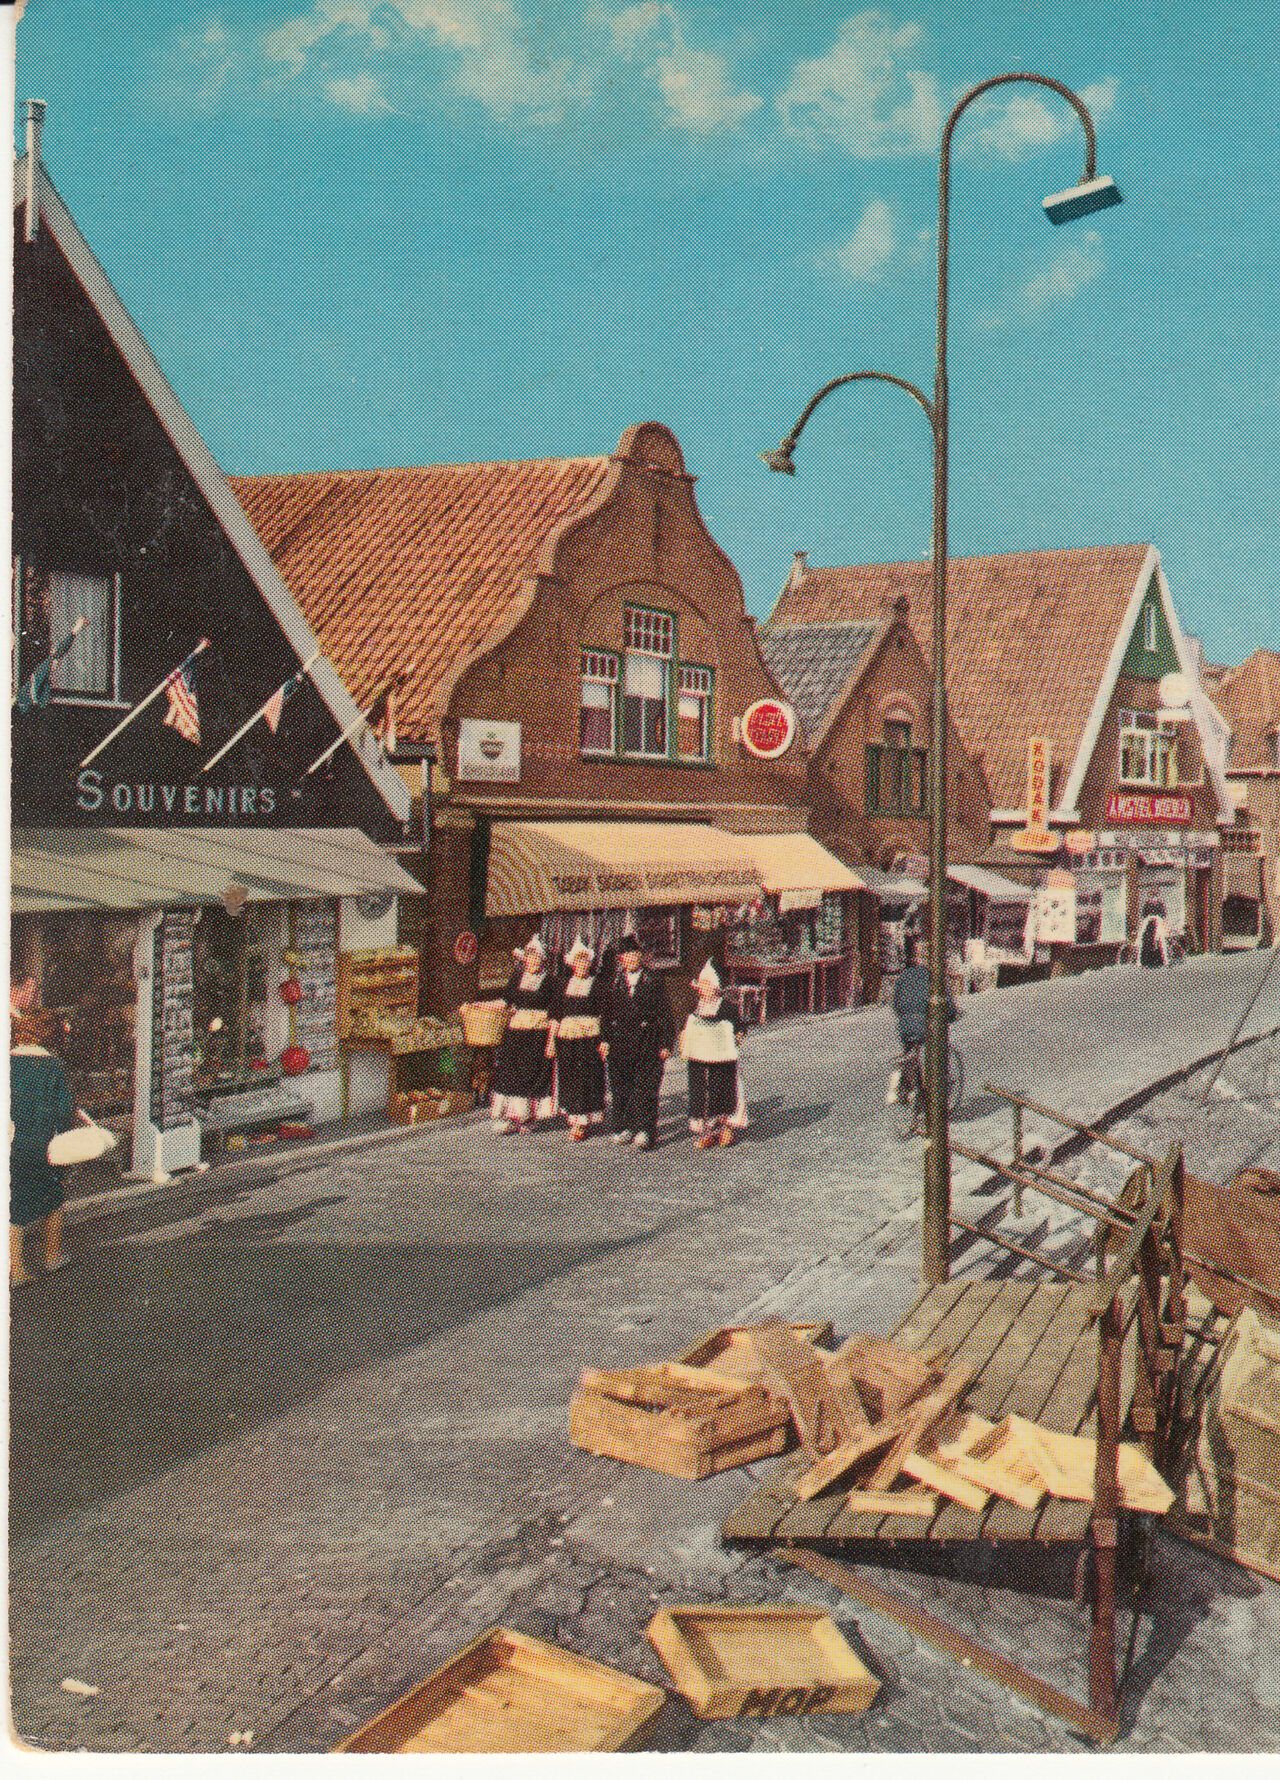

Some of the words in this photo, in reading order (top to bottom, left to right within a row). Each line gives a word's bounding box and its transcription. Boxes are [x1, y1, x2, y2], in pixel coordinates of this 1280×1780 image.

[75, 769, 276, 814] SOUVENIRS
[1031, 742, 1045, 823] KODAK
[1109, 795, 1152, 818] AMSTEL
